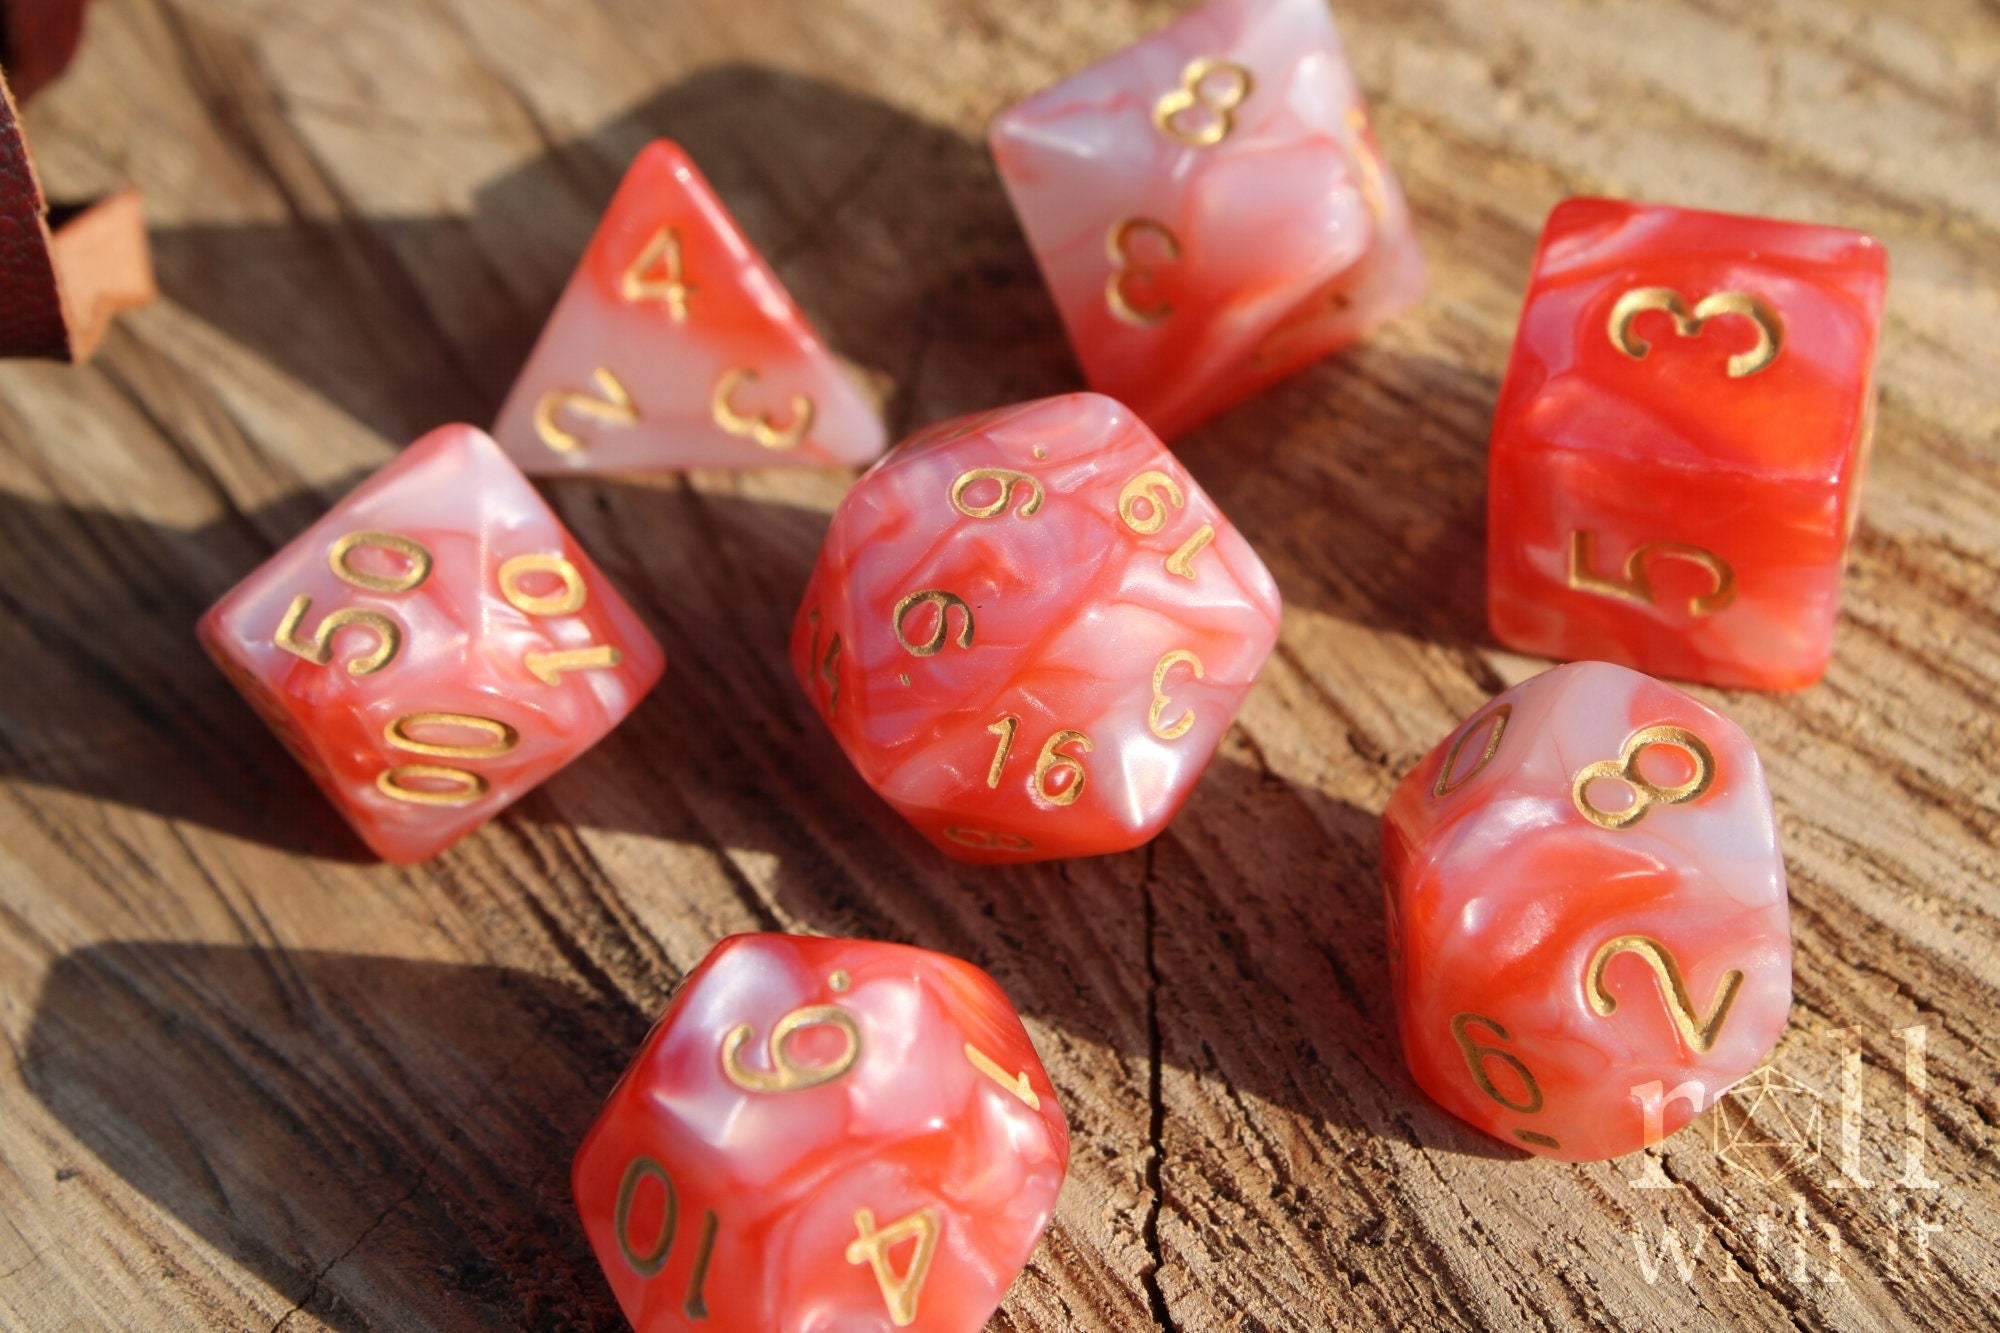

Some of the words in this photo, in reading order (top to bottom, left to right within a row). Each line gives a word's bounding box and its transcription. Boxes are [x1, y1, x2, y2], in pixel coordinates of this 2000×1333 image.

[1155, 57, 1253, 145] 8
[623, 227, 694, 322] 4
[1106, 217, 1180, 327] 3
[1608, 286, 1785, 378] 3
[534, 367, 640, 453] 2
[712, 369, 812, 449] 3
[274, 530, 433, 678] 50
[499, 554, 621, 685] 10
[1569, 529, 1738, 617] 5
[1149, 649, 1204, 740] 3
[987, 716, 1093, 806] 16
[1434, 703, 1512, 797] 0
[1573, 725, 1716, 830] 8
[1588, 936, 1743, 1052] 2
[965, 1043, 1040, 1111] 1
[846, 1206, 940, 1326] 4
